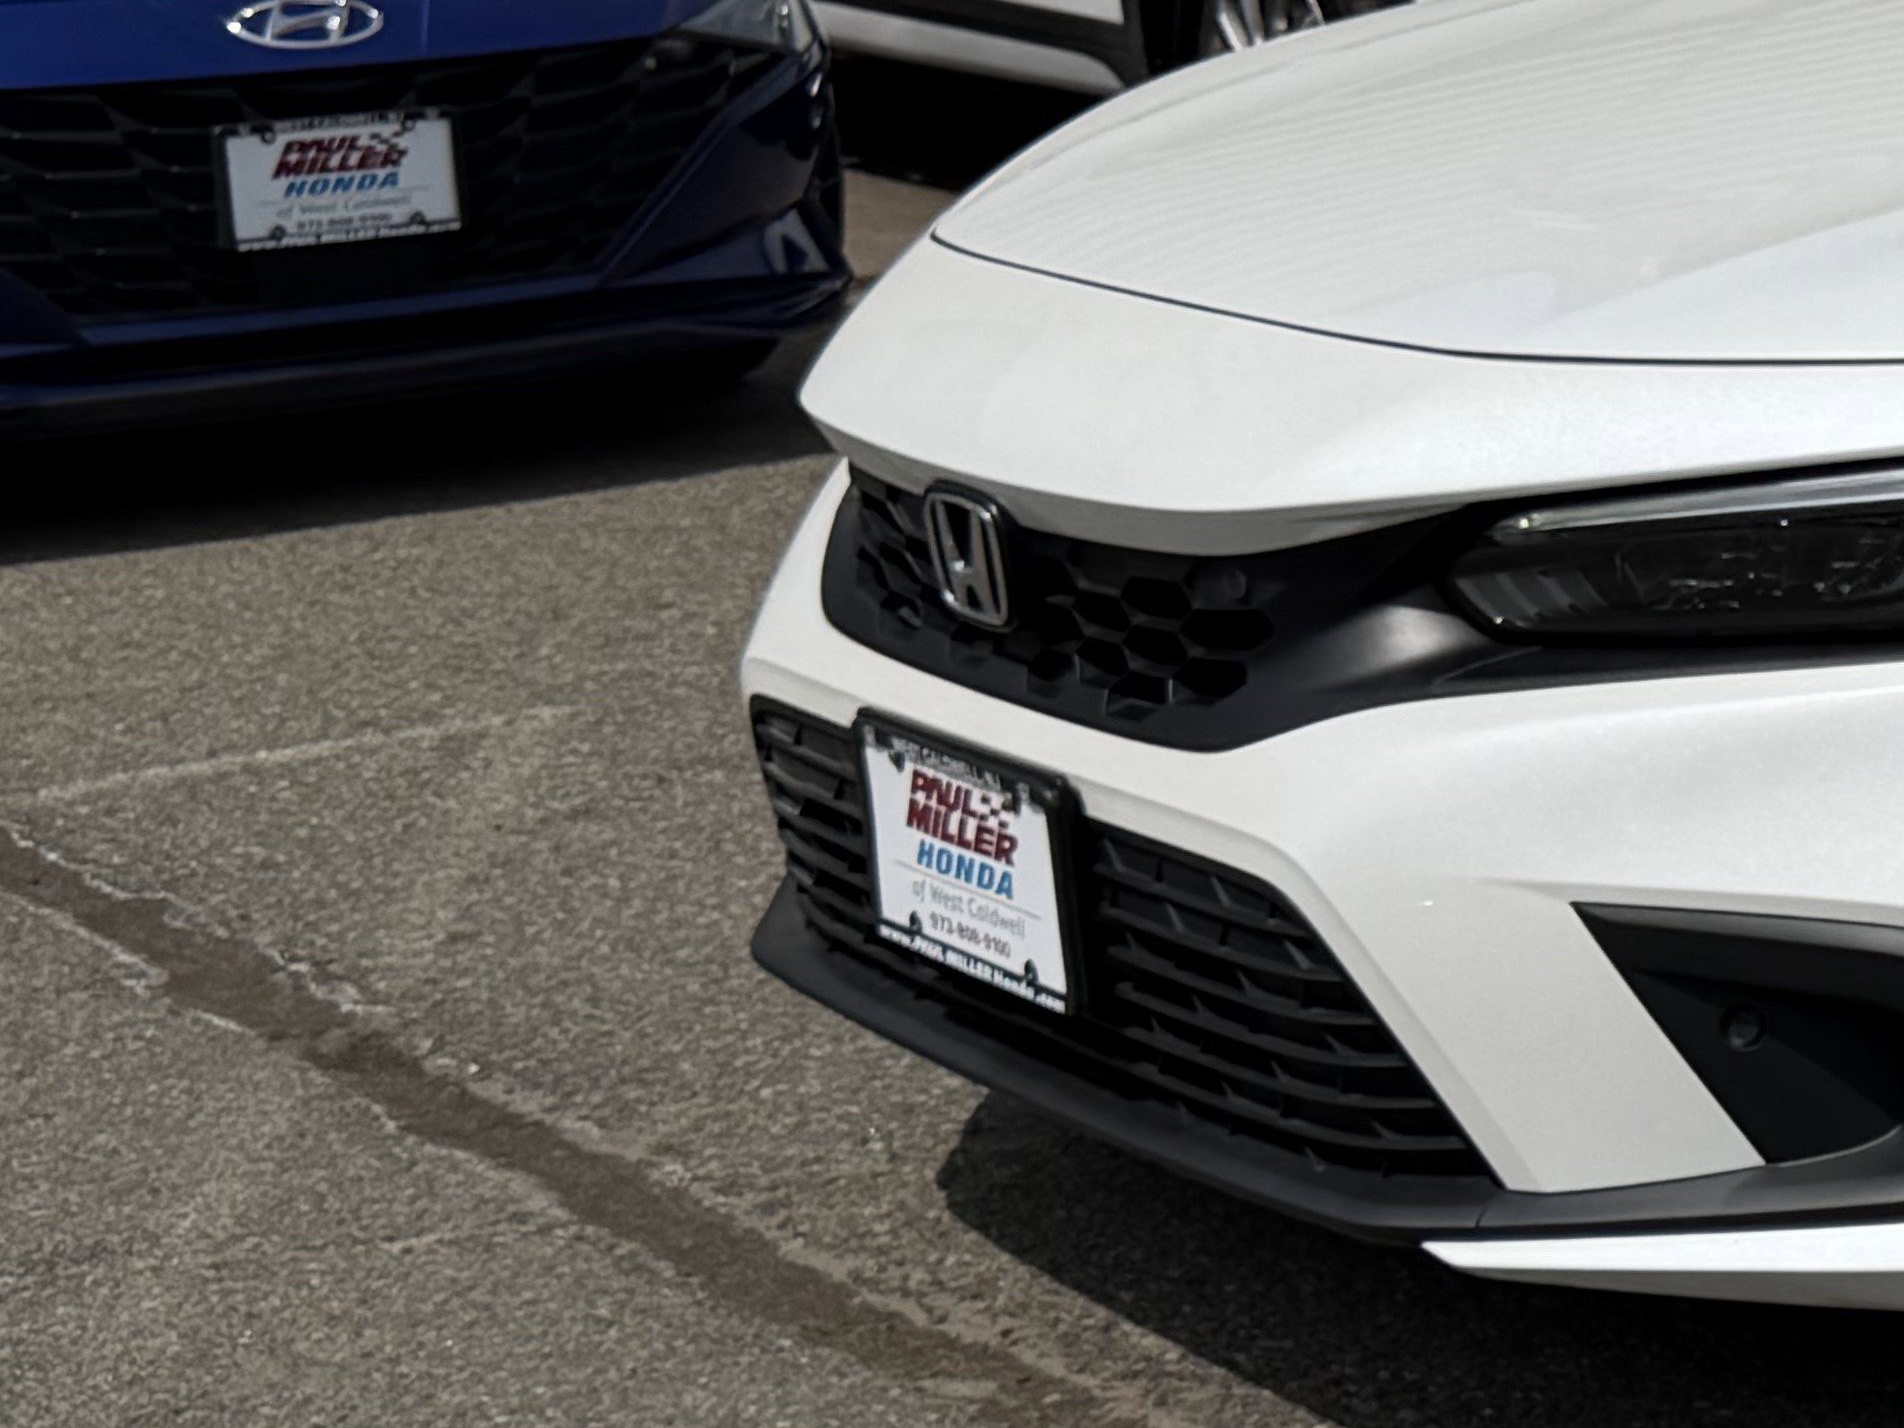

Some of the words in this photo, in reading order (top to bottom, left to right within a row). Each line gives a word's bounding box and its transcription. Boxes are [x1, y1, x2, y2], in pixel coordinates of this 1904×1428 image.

[271, 144, 409, 180] MILLER
[284, 133, 364, 160] PAUL
[283, 171, 400, 199] HONDA
[910, 768, 986, 820] PAUL
[906, 797, 1019, 867] MILLER
[916, 838, 1014, 900] HONDA
